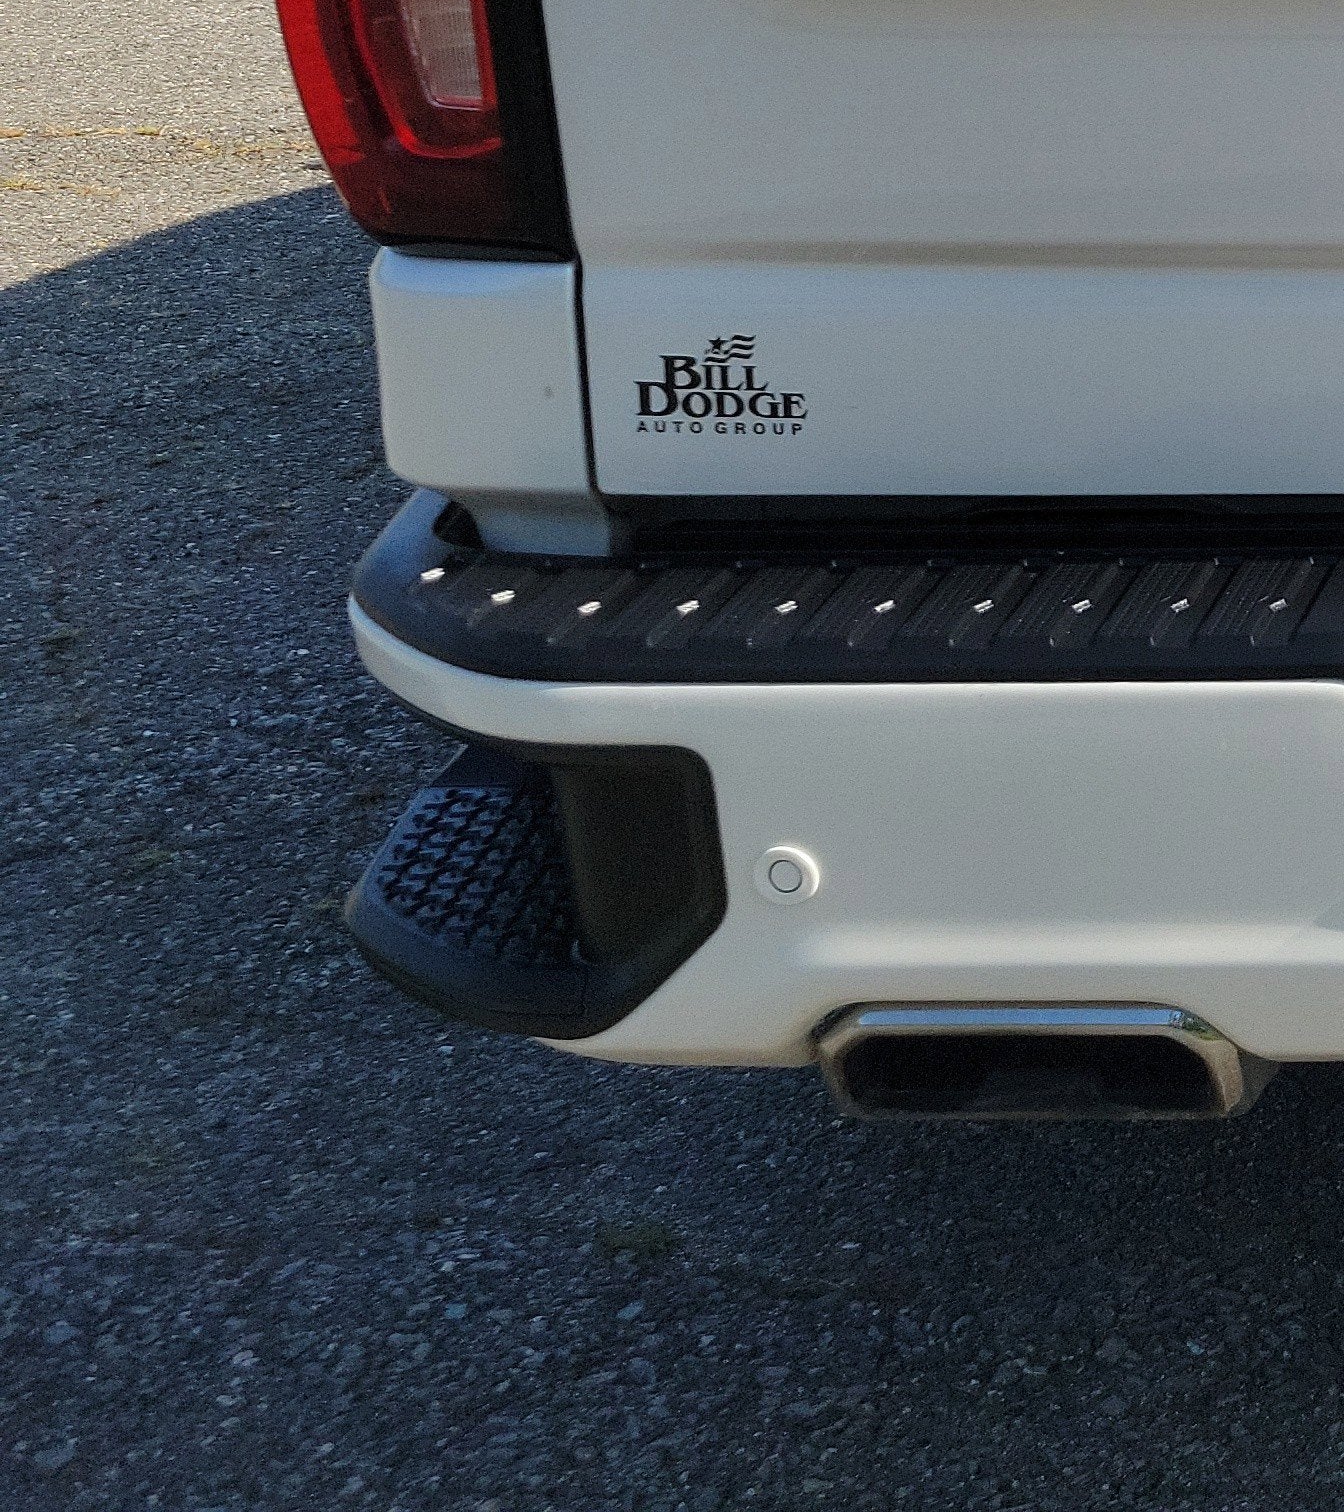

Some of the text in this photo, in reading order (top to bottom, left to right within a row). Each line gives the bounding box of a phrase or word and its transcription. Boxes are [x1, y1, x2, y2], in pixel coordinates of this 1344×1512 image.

[659, 354, 769, 391] BILL
[633, 380, 808, 419] DODGE
[636, 420, 804, 436] AUTO GROUP
